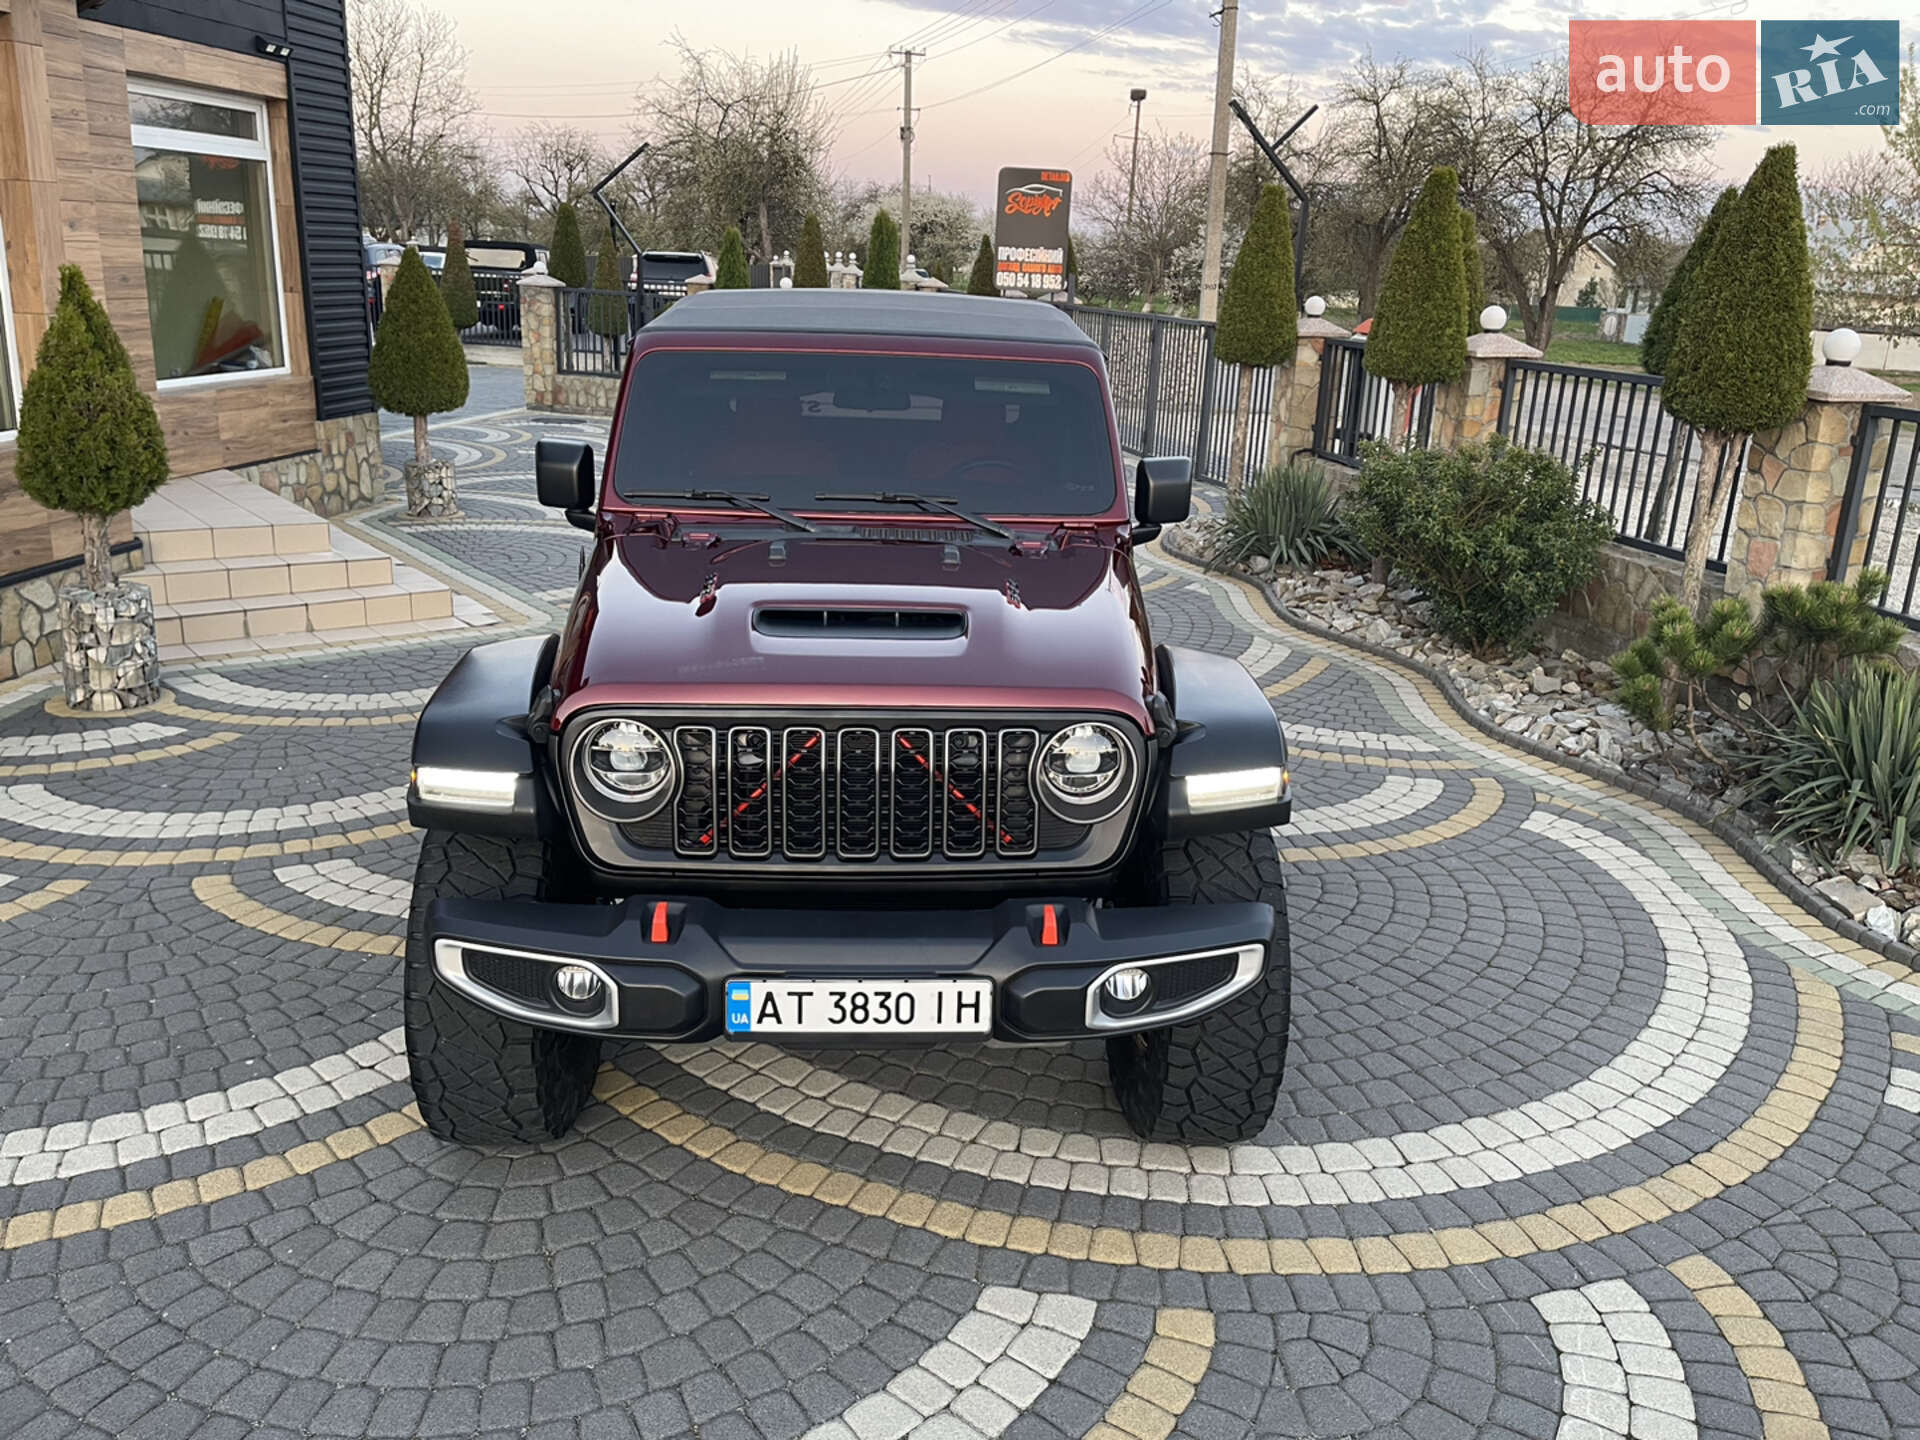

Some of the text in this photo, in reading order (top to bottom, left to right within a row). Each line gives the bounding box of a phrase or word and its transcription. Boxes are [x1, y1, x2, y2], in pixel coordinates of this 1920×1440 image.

[731, 1014, 749, 1024] UA
[756, 991, 980, 1025] AT 3830 IH
